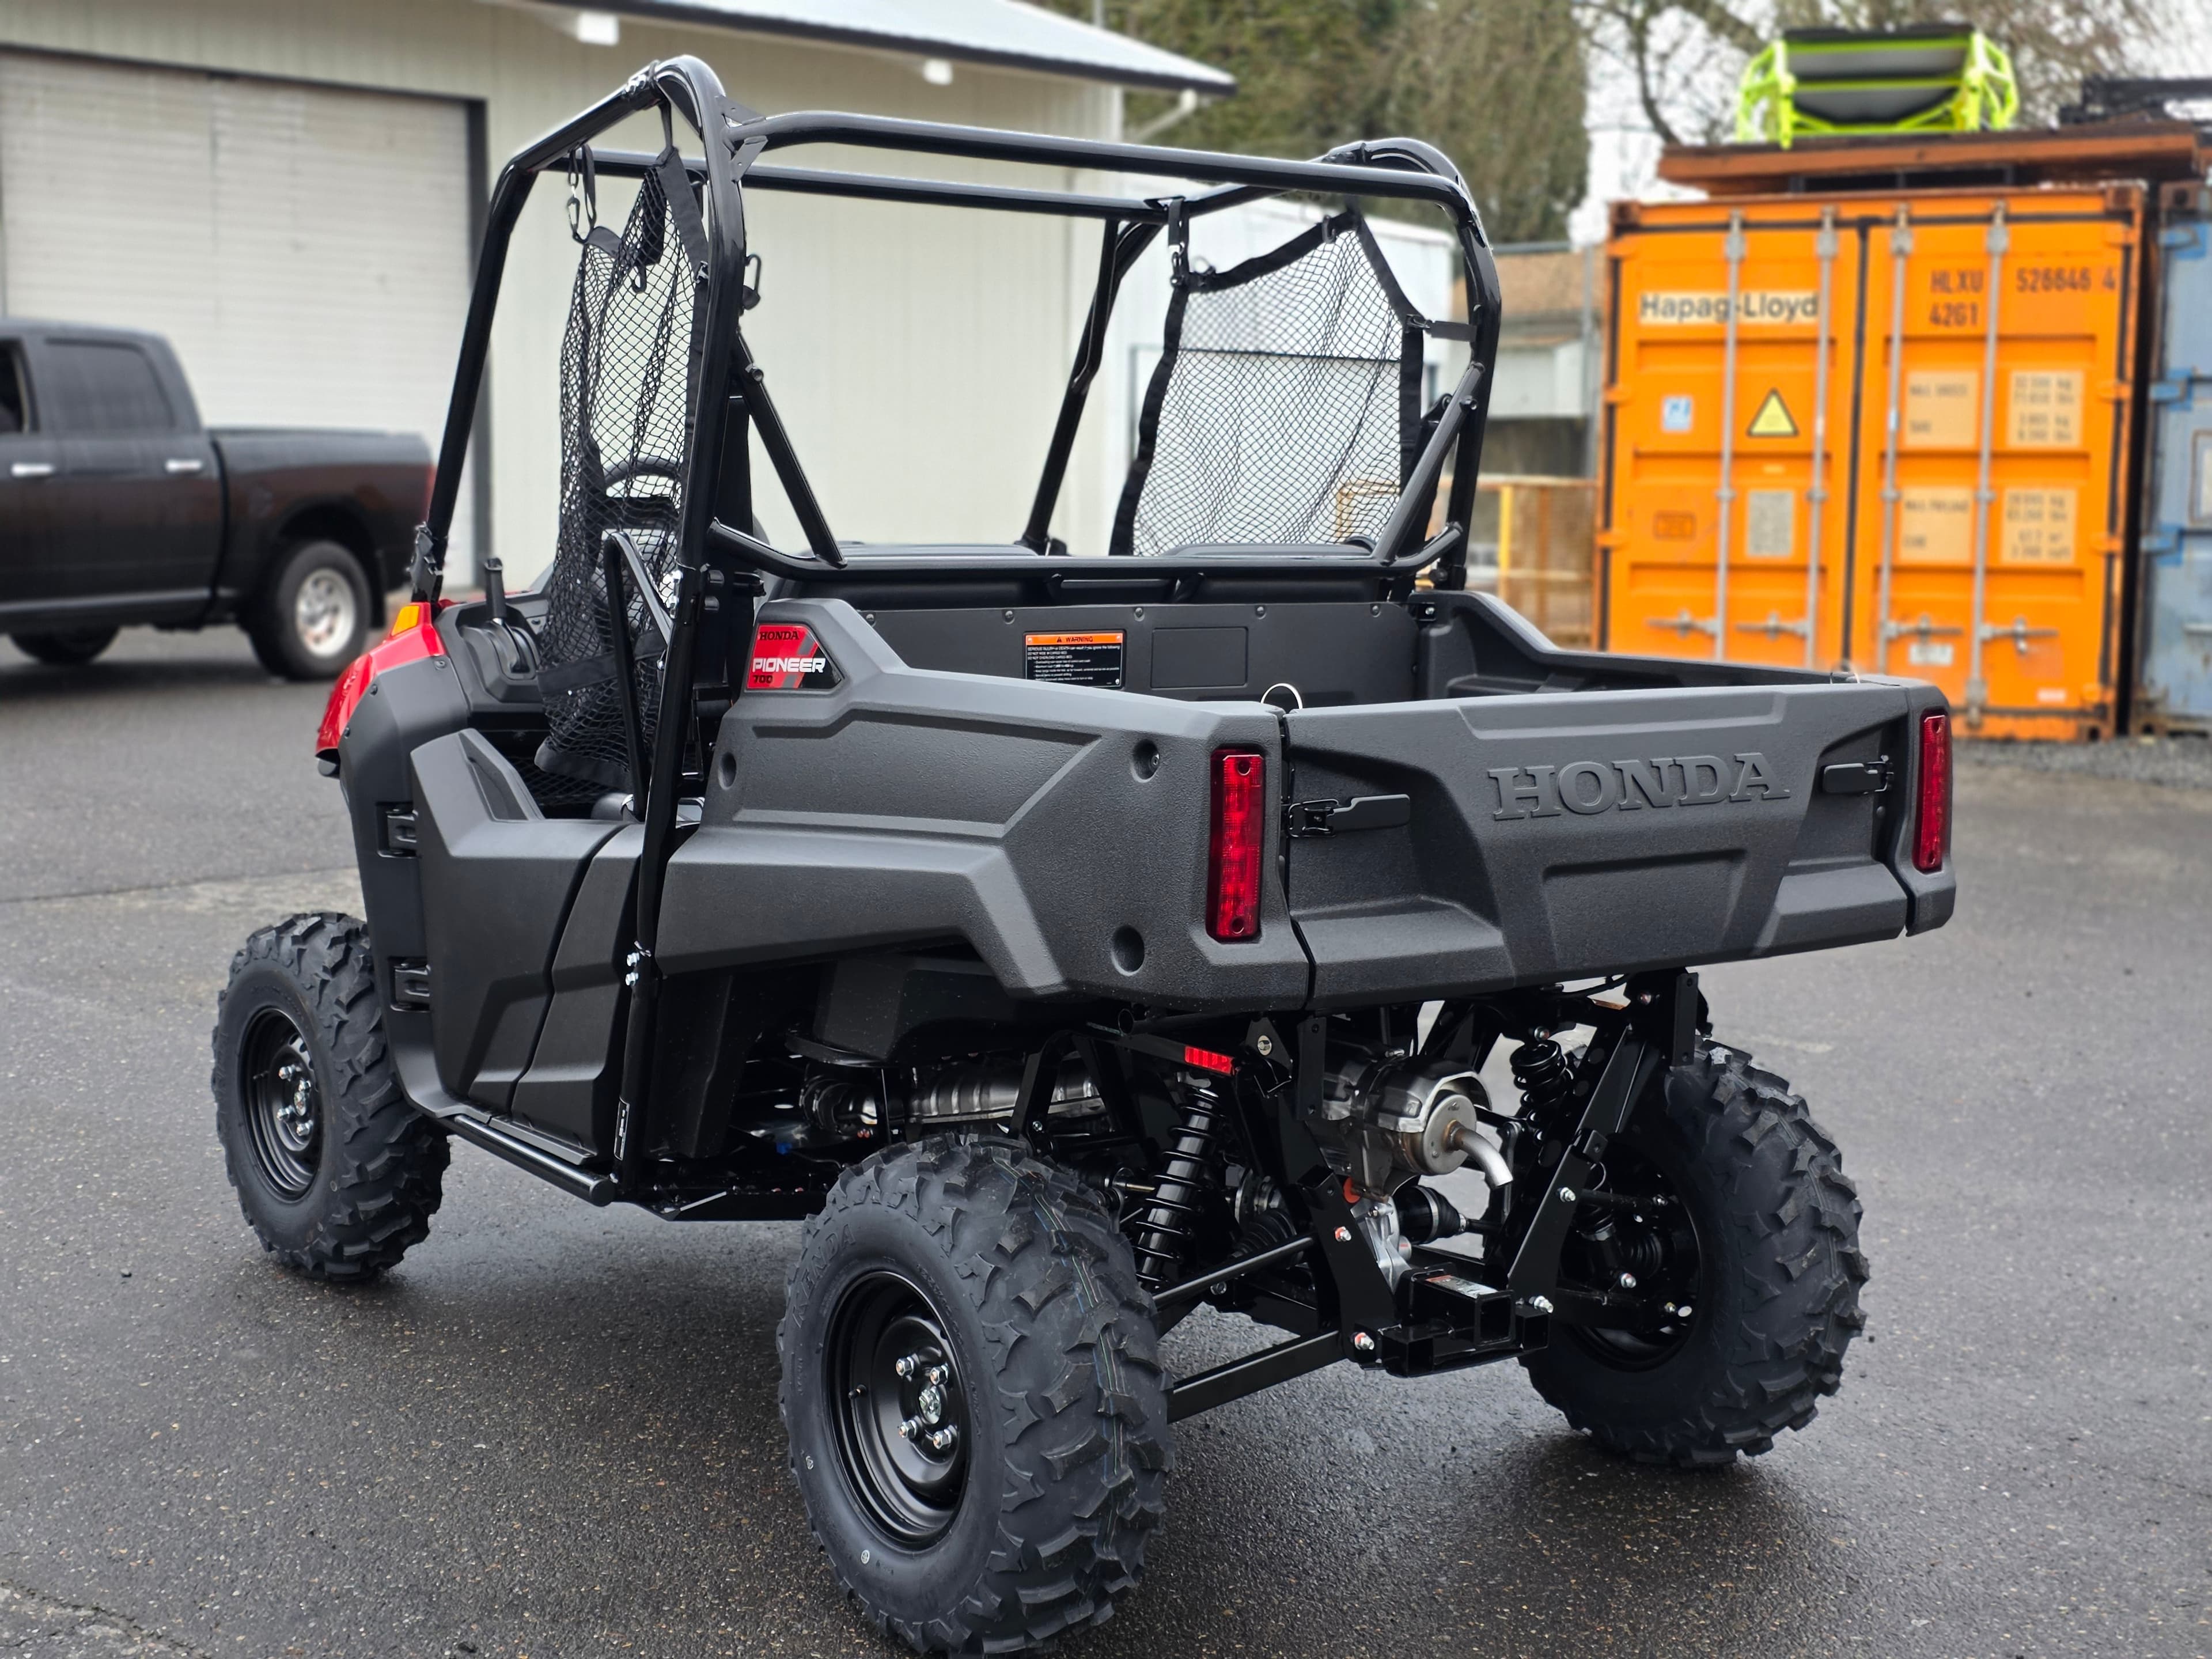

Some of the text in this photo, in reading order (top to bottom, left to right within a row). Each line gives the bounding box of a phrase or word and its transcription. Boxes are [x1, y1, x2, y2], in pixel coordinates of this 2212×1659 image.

[1641, 291, 1819, 323] Hapag-Lloyd
[759, 630, 799, 641] HONDA
[752, 657, 825, 673] PIONEER
[752, 675, 773, 684] 700
[1487, 752, 1791, 821] HONDA
[793, 1224, 856, 1328] KENDA
